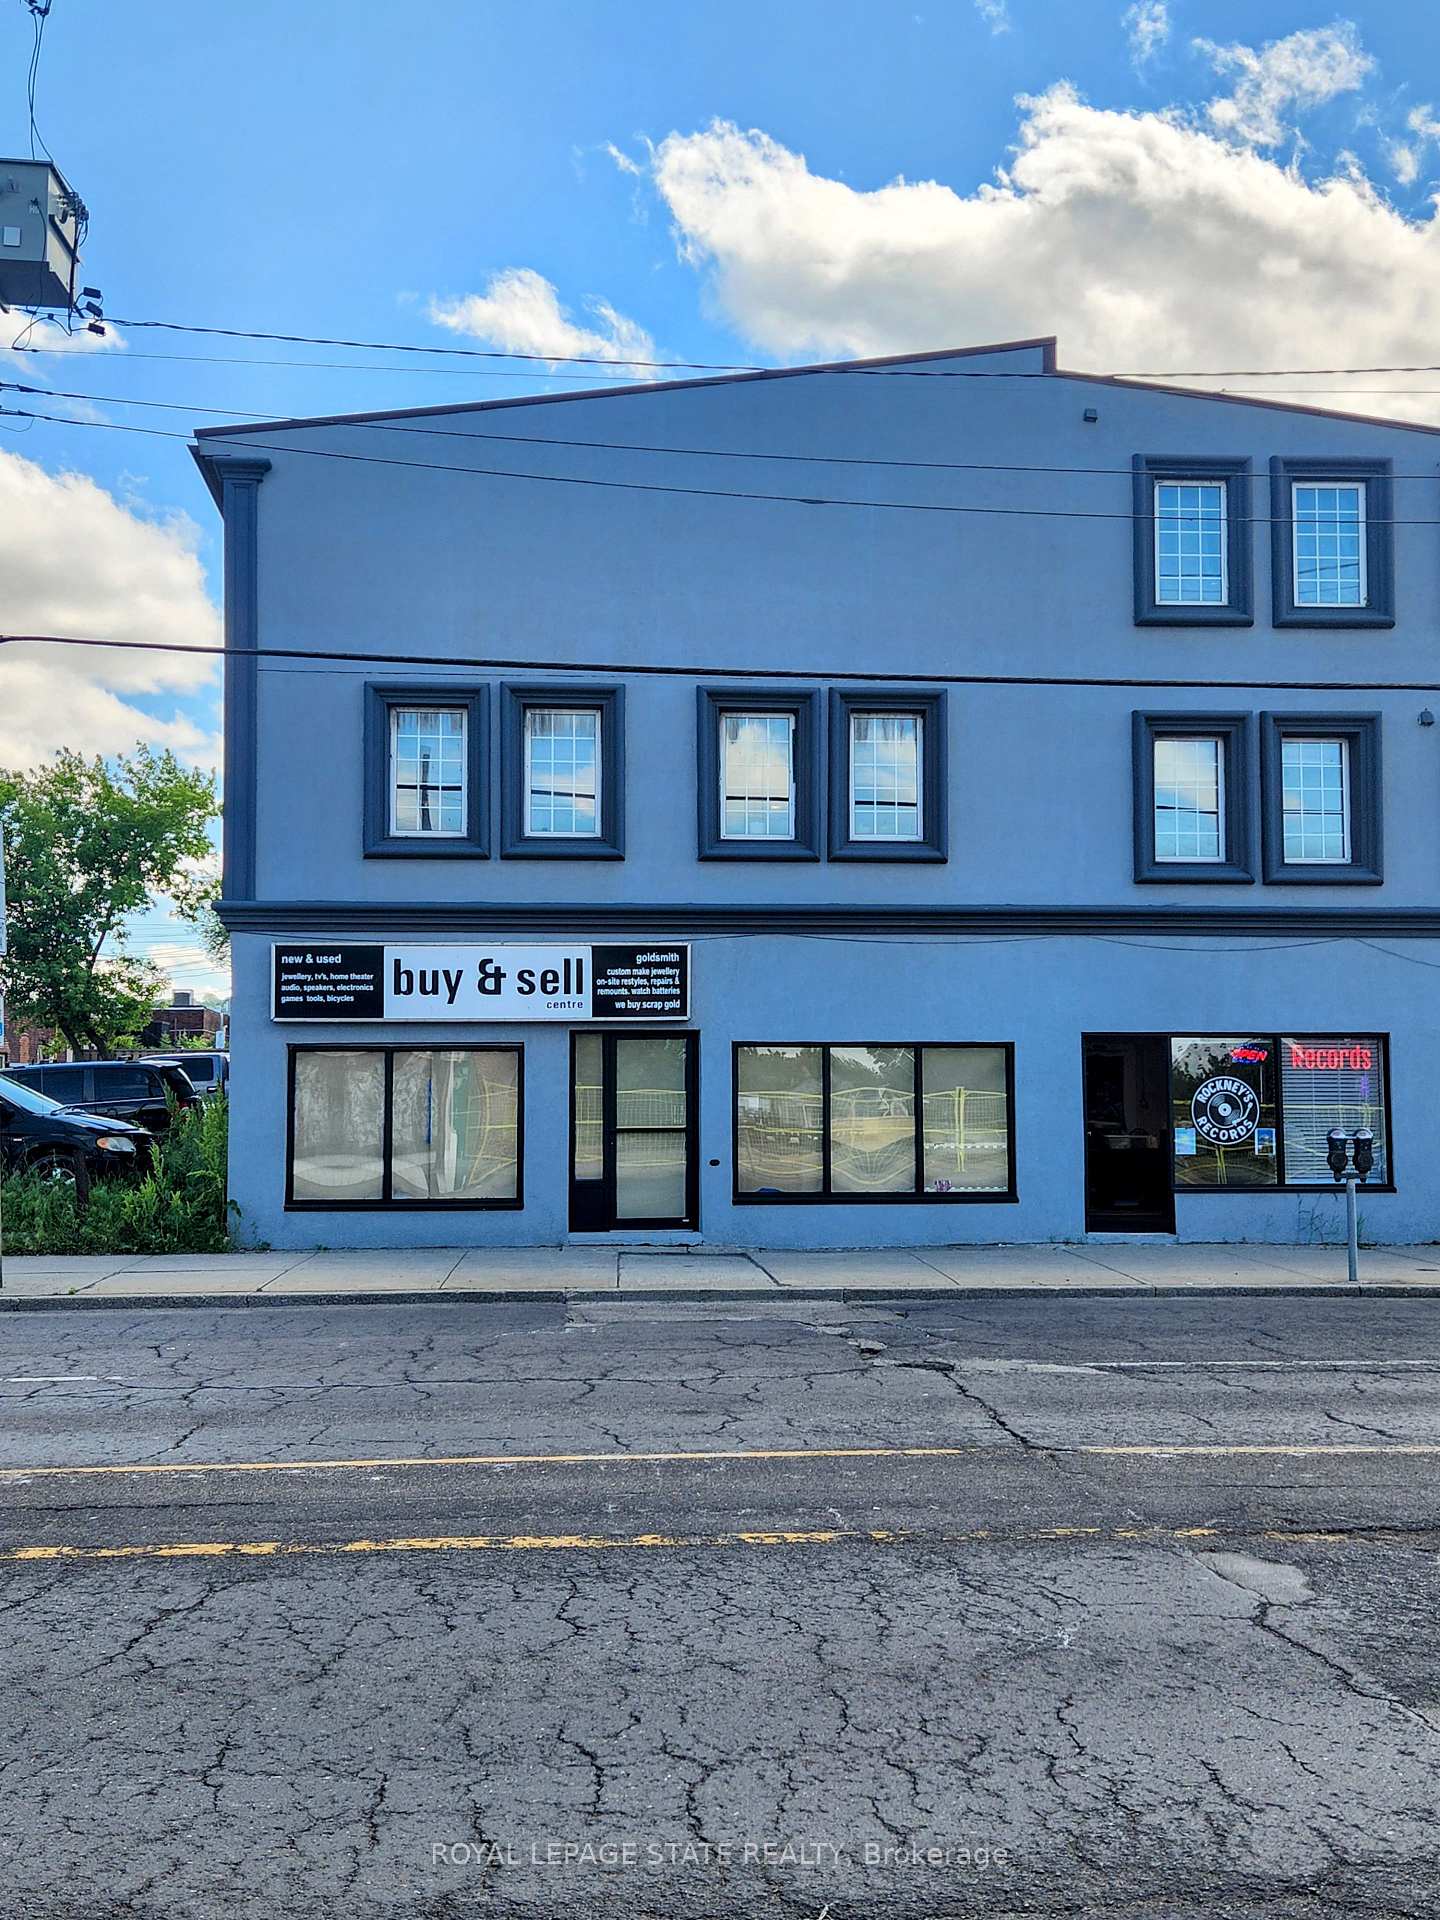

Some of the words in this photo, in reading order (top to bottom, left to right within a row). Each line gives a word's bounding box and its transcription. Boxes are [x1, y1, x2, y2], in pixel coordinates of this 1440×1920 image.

[281, 955, 303, 964] new
[305, 953, 314, 964] &
[316, 953, 342, 964] used
[636, 952, 680, 965] goldsmith
[281, 972, 314, 982] jewellery,
[329, 972, 349, 980] home
[350, 972, 374, 980] theater
[606, 968, 632, 976] custom
[632, 967, 650, 976] make
[650, 967, 680, 978] jewellery
[393, 958, 464, 1005] buy
[477, 958, 507, 995] &
[517, 958, 584, 995] sell
[596, 977, 621, 986] on-site
[621, 977, 650, 987] restyles,
[650, 976, 674, 987] repairs
[674, 977, 680, 985] &
[281, 984, 303, 992] audio,
[303, 984, 336, 993] speakers,
[631, 987, 651, 995] watch
[651, 986, 680, 995] batteries
[281, 995, 304, 1004] games
[306, 995, 326, 1003] tools,
[326, 995, 355, 1003] bicycles
[546, 1000, 584, 1009] centre
[614, 1001, 626, 1009] we
[627, 1000, 641, 1011] buy
[641, 1001, 663, 1011] scrap
[664, 1000, 681, 1010] gold
[1291, 1044, 1372, 1070] Records
[1196, 1079, 1254, 1104] ROCKNEY'S
[1196, 1115, 1254, 1141] RECORDS
